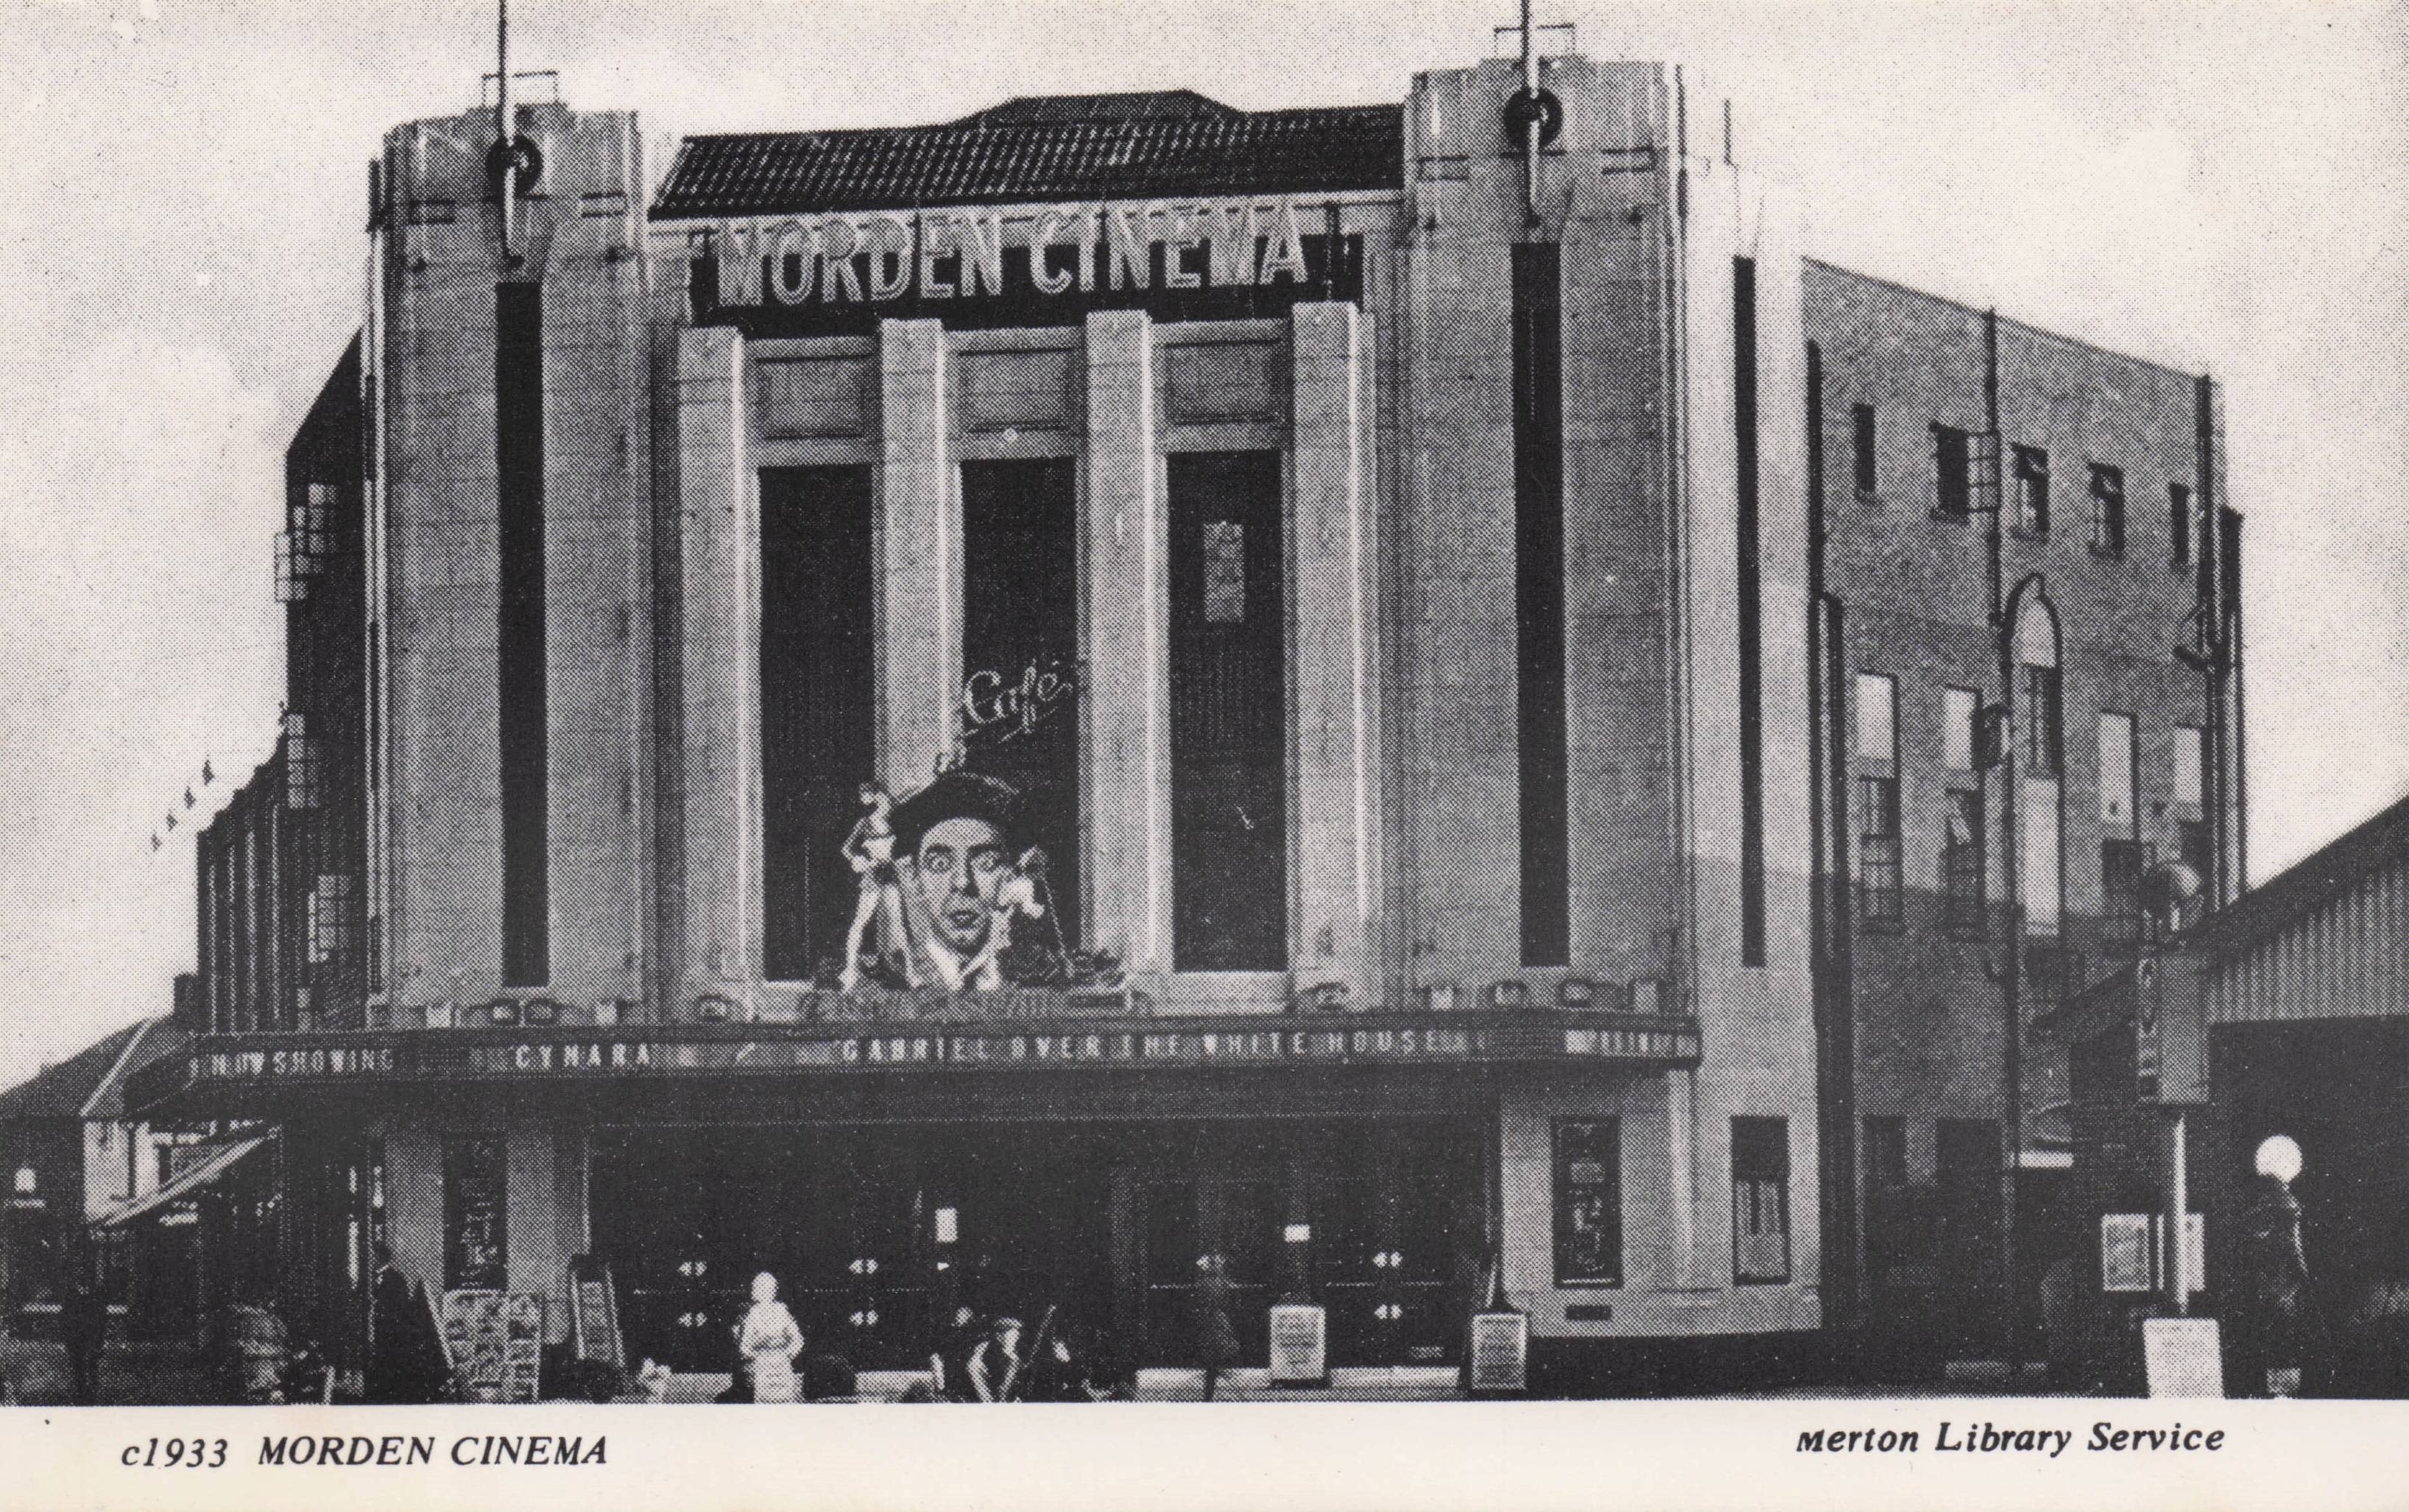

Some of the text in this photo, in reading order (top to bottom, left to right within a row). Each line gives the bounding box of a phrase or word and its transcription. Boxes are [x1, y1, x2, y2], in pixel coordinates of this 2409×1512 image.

[718, 203, 1308, 306] MORDEN CINEMA
[963, 659, 1074, 735] Café
[211, 1048, 394, 1075] NOW SHOWING
[514, 1042, 650, 1069] CYNARA
[842, 1030, 1436, 1062] GABRIEL OVER THE WHITE HOUSE
